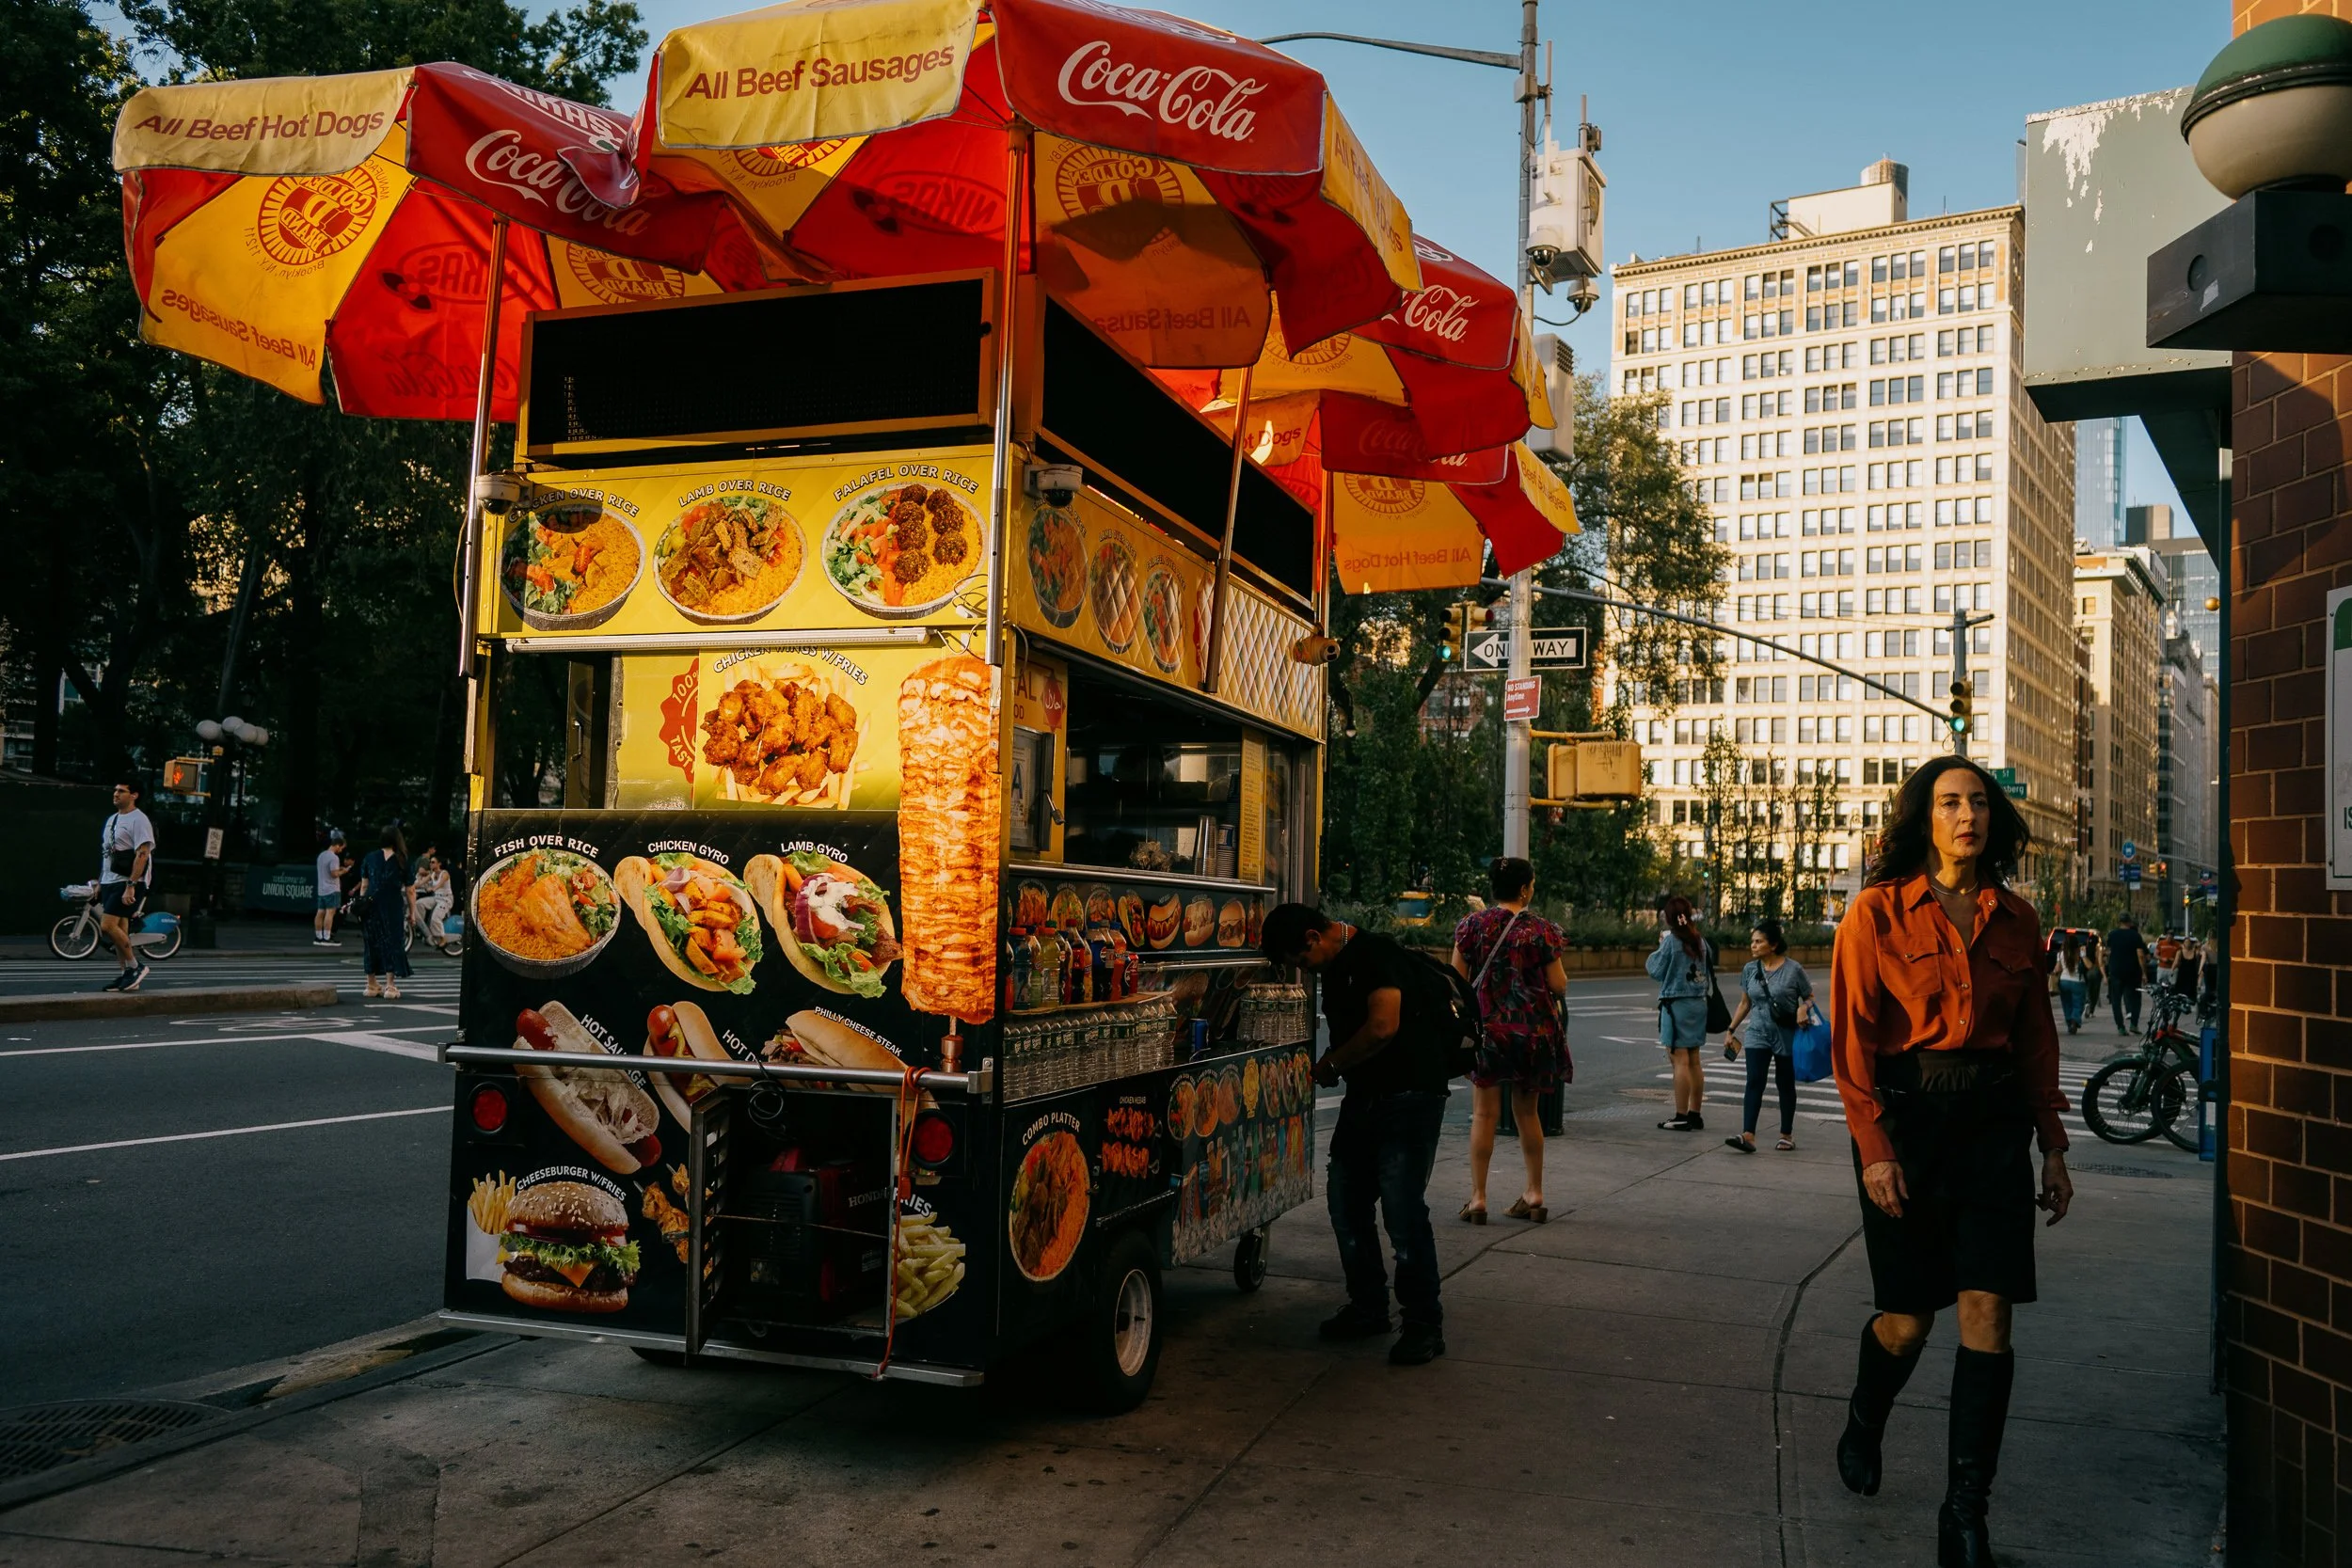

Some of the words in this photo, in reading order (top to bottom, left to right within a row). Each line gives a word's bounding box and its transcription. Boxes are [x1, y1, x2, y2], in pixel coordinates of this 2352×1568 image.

[685, 71, 728, 100] All
[736, 60, 805, 98] Beef
[810, 45, 955, 87] Sausages
[1057, 40, 1269, 141] Coca-Cola
[134, 115, 184, 136] All
[185, 117, 258, 141] Beef
[260, 114, 310, 140] Hot
[314, 111, 385, 139] Dogs
[1259, 426, 1302, 448] Dogs
[678, 483, 715, 507] LAMB
[718, 480, 755, 494] OVER
[757, 482, 792, 501] RICE
[834, 467, 895, 501] FALAFEL
[898, 464, 939, 481] OVER
[942, 469, 979, 495] RICE
[509, 490, 564, 522] CHCKEN
[569, 488, 604, 502] OVER
[607, 494, 640, 517] RICE
[1484, 641, 1509, 657] ON
[1533, 641, 1569, 657] WAY
[713, 646, 771, 673] CHICKEN
[820, 646, 868, 686] W/FRIES
[672, 671, 699, 704] 100
[1507, 683, 1514, 692] NO
[1515, 680, 1535, 691] STANDING
[1014, 704, 1025, 720] OD
[670, 735, 695, 773] TAST
[494, 838, 526, 858] FISH
[529, 835, 564, 847] OVER
[567, 839, 600, 859] RICE
[647, 840, 697, 853] CHICKEN
[698, 844, 730, 865] GYRO
[780, 841, 815, 853] LAMB
[816, 842, 850, 864] GYRO
[262, 882, 285, 896] UNION
[285, 884, 314, 900] SQUARE
[580, 1014, 608, 1039] HOT
[814, 1006, 844, 1023] PHILLY
[844, 1017, 877, 1040] CHEESE
[875, 1034, 904, 1057] STEAK
[722, 1029, 748, 1056] HOT
[1022, 1114, 1049, 1146] COMBO
[1051, 1111, 1081, 1133] PLATTER
[516, 1165, 588, 1191] CHEESEBURGER
[591, 1171, 627, 1201] W/FRIES
[848, 1189, 889, 1209] HONDA
[893, 1187, 932, 1217] FIES
